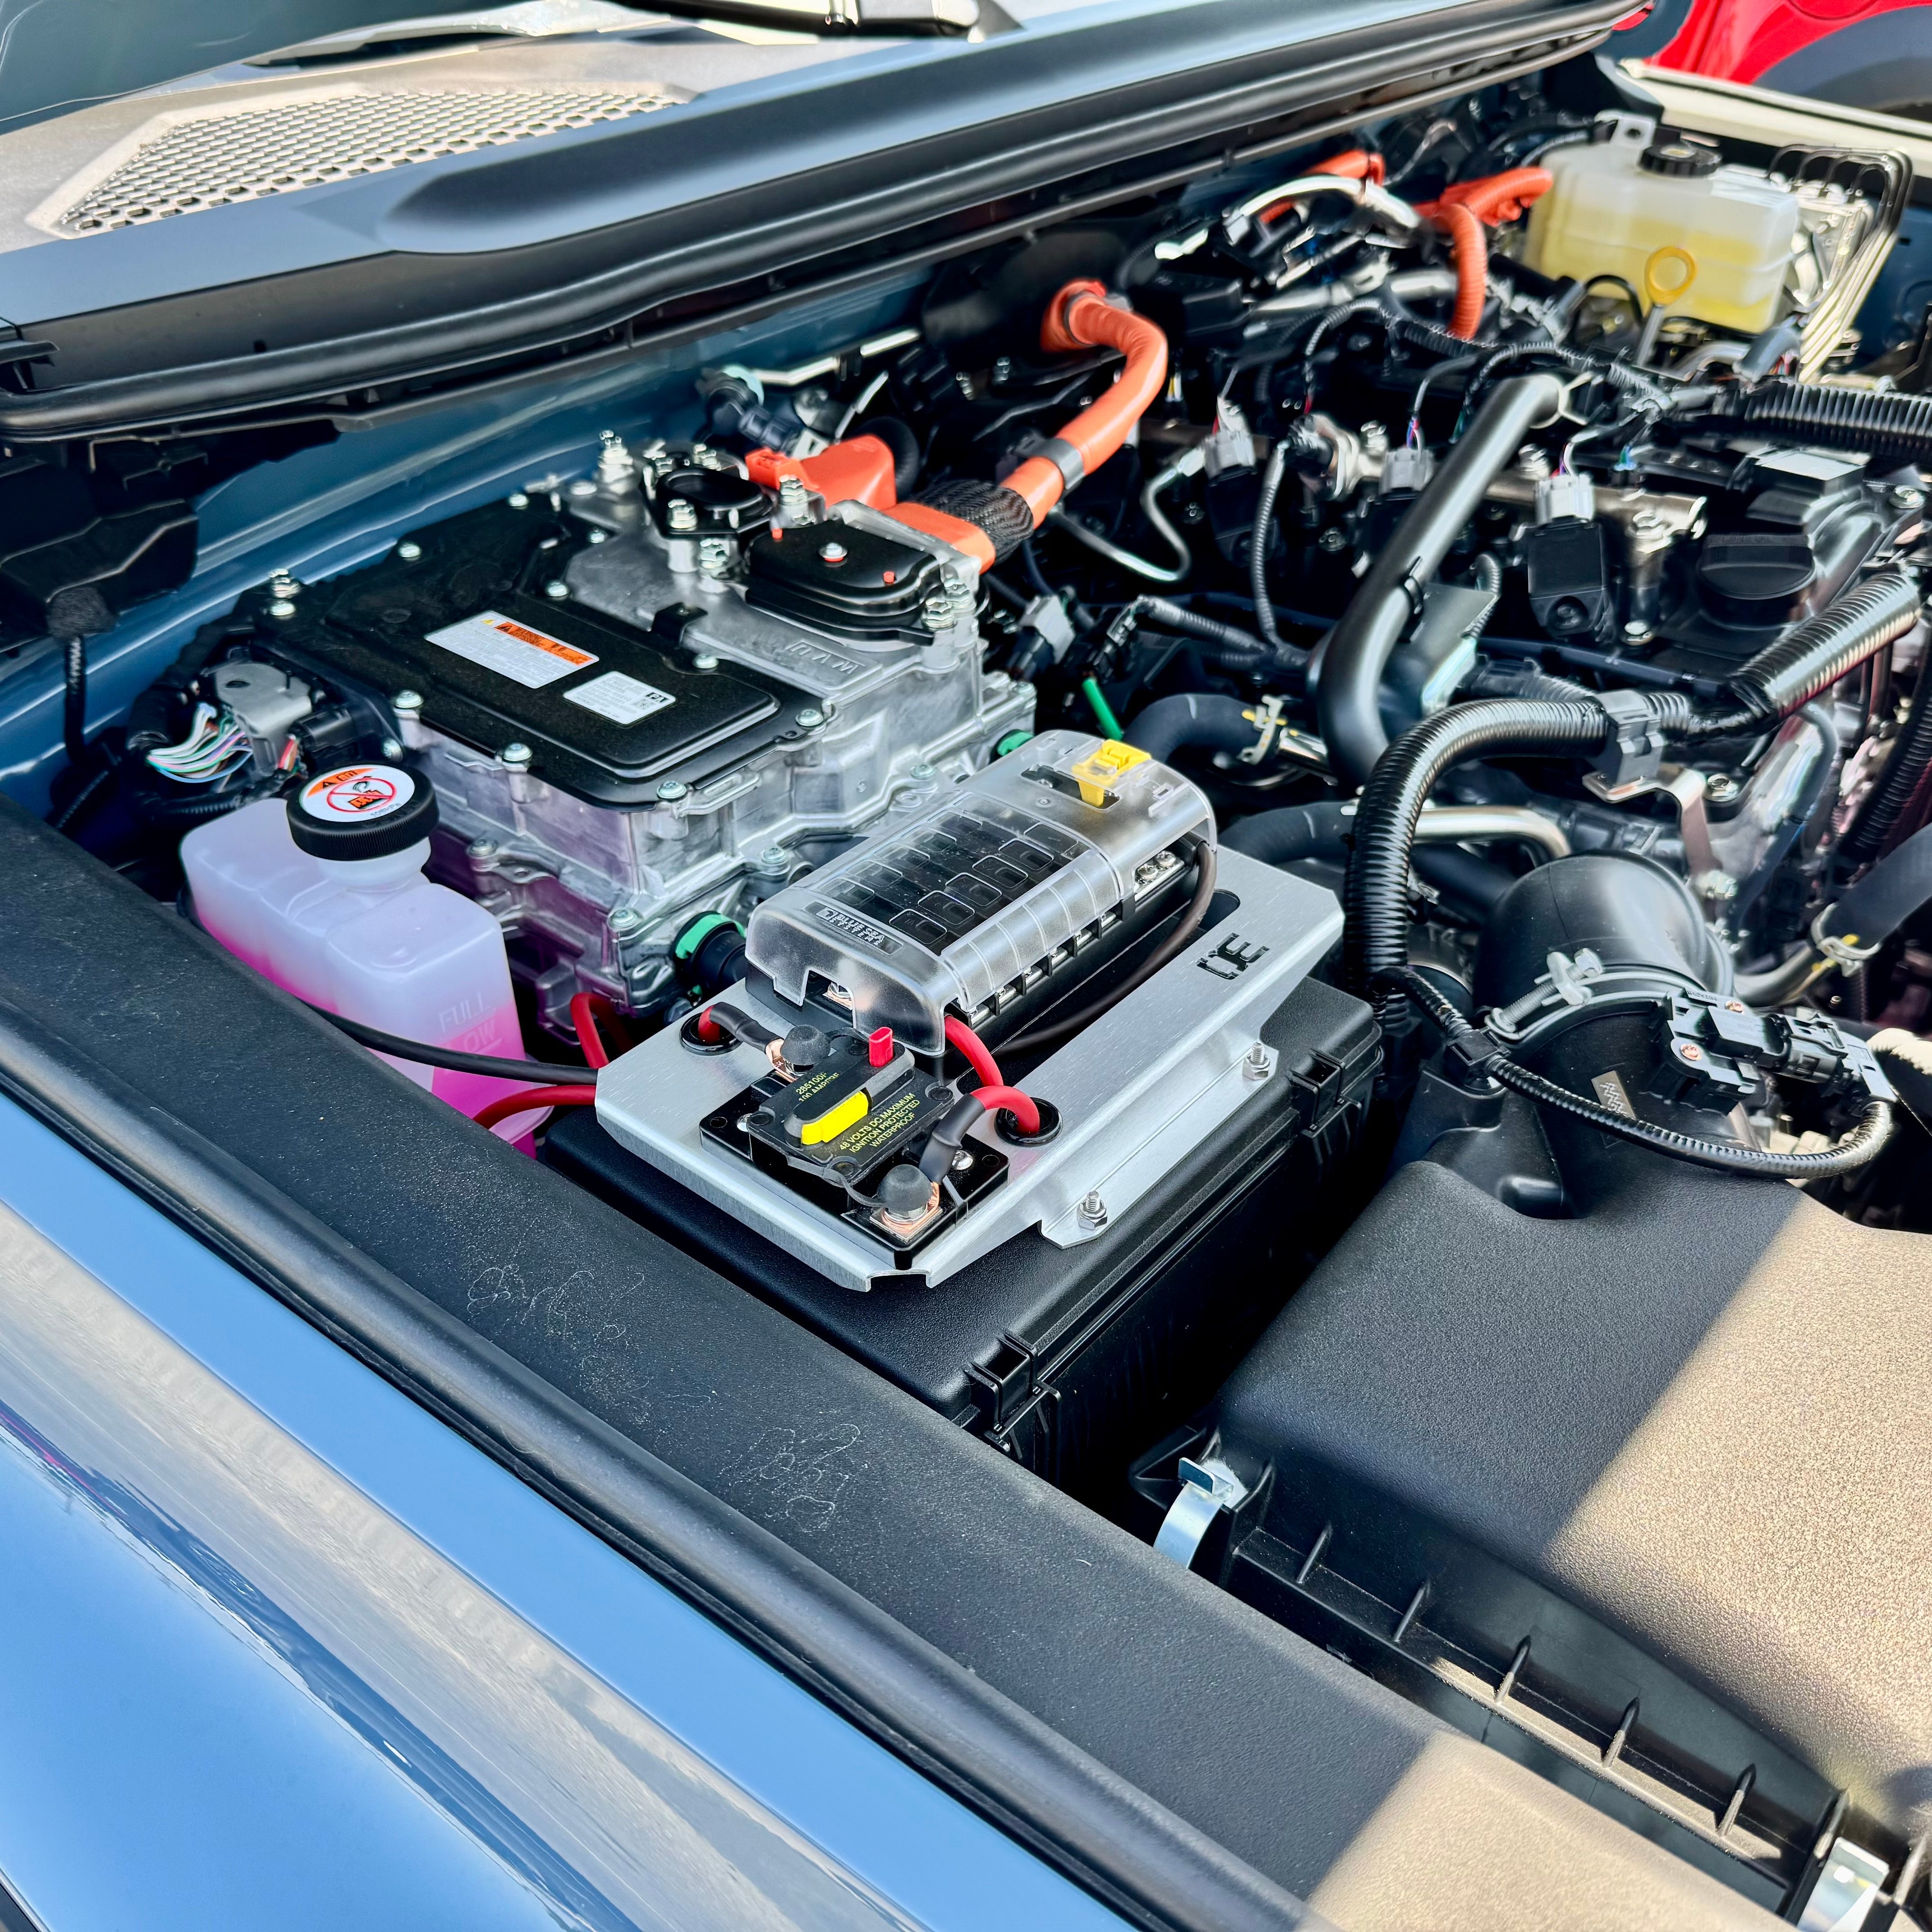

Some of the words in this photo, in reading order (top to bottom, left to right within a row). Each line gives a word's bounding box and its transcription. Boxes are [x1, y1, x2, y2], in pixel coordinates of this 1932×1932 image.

[835, 914, 865, 931] BLUE
[863, 928, 885, 943] SEA
[439, 991, 492, 1034] FULL
[459, 1016, 497, 1052] OW
[840, 1141, 851, 1150] 48
[847, 1125, 872, 1143] VOLTS
[869, 1117, 883, 1127] DC
[879, 1093, 916, 1119] MAXIMUM
[849, 1128, 882, 1153] IGNITION
[879, 1099, 920, 1130] PROTECTED
[869, 1112, 915, 1147] WATERPROOF
